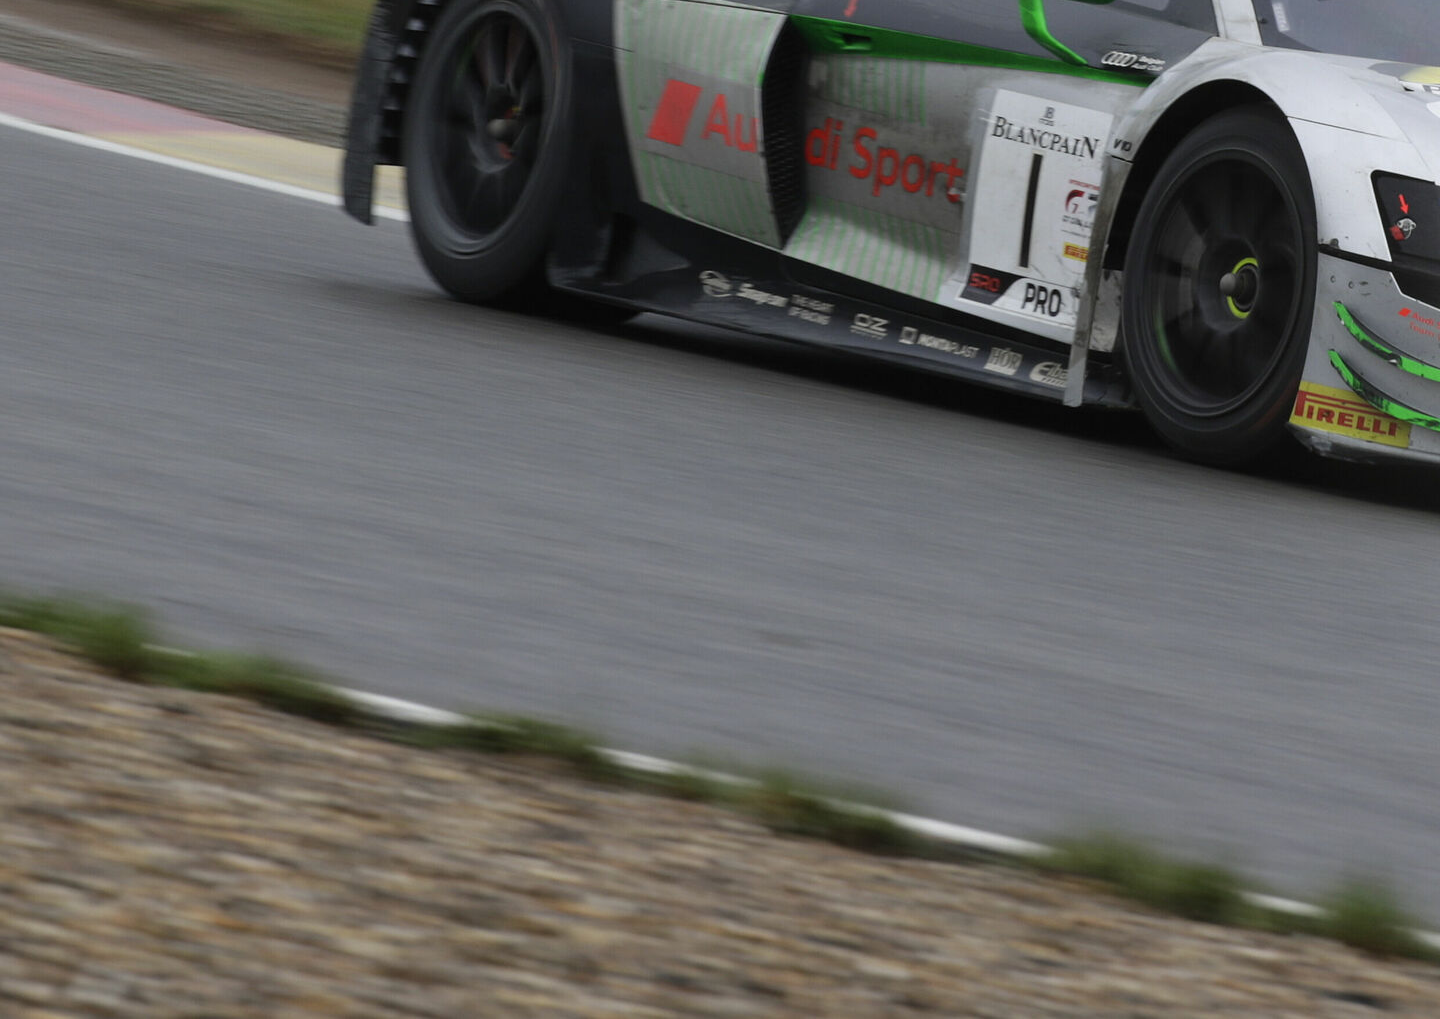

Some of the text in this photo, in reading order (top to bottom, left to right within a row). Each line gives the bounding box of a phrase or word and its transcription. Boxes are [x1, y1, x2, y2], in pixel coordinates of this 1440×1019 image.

[991, 114, 1100, 160] BLANCPAIN
[848, 126, 965, 204] Sport
[1021, 282, 1063, 317] PRO
[1411, 312, 1435, 326] Audi
[1293, 390, 1399, 437] PIRELLI
